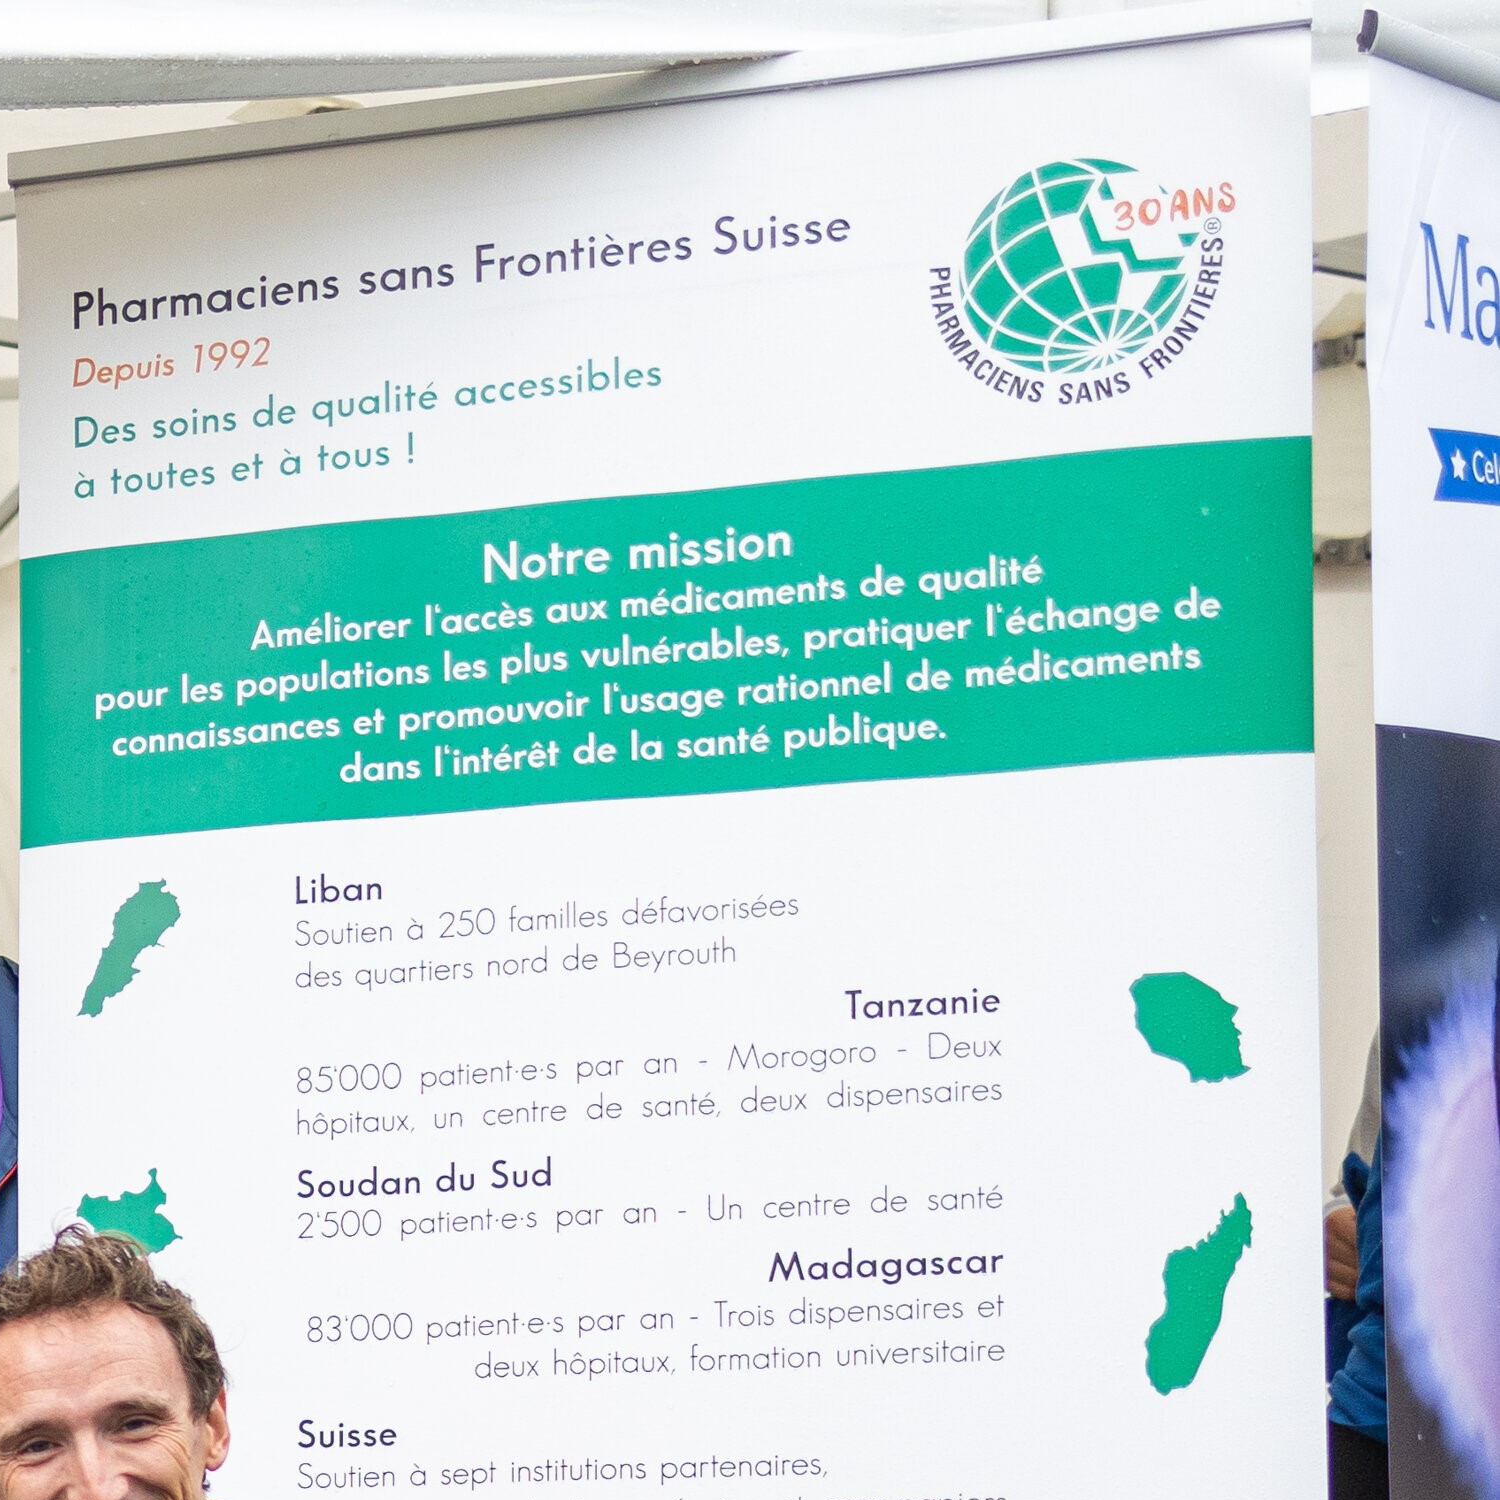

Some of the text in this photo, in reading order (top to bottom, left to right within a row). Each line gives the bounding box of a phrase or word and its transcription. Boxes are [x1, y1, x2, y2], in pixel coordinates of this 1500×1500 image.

[1112, 182, 1236, 231] 30 ANS
[74, 216, 851, 329] Pharmaciens sans Frontières Suisse
[929, 266, 1045, 404] PHARMACIENS
[1058, 371, 1131, 405] SANS
[72, 336, 271, 391] Depuis 1992
[74, 355, 662, 448] Des soins de qualité accessibles
[74, 445, 390, 499] à toutes et à tous
[484, 527, 792, 583] Notre mission
[251, 612, 411, 650] Améliorer
[546, 600, 608, 623] aux
[621, 574, 847, 617] médicaments
[860, 564, 905, 597] de
[919, 554, 1043, 600] qualité
[96, 687, 168, 720] pour
[182, 673, 224, 703] les
[237, 659, 430, 706] populations
[444, 650, 488, 681] les
[501, 642, 568, 684] plus
[581, 625, 789, 668] vulnérables,
[804, 618, 971, 658] pratiquer
[1174, 586, 1221, 619] de
[112, 718, 340, 756] connaissances
[353, 709, 385, 735] et
[399, 691, 589, 740] promouvoir
[738, 661, 891, 705] rationnel
[906, 658, 951, 692] de
[966, 643, 1201, 687] médicaments
[340, 751, 421, 783] dans
[573, 732, 617, 764] de
[631, 729, 663, 760] la
[678, 725, 770, 758] santé
[784, 712, 946, 757] publique.
[296, 873, 382, 905] Liban
[295, 894, 799, 946] Soutien à 250 familles défavorisées
[295, 936, 736, 992] des quartiers nord de Beyrouth
[844, 988, 1000, 1020] Tanzanie
[577, 1059, 624, 1084] par
[644, 1058, 678, 1074] an
[728, 1043, 876, 1073] Morogoro
[928, 1032, 1002, 1060] Deux
[297, 1080, 1002, 1141] hôpitaux, un centre de santé, deux dispensaires
[297, 1155, 551, 1199] Soudan du Sud
[557, 1209, 604, 1234] par
[623, 1207, 656, 1224] an
[708, 1193, 742, 1221] Un
[763, 1193, 850, 1219] centre
[870, 1184, 908, 1213] de
[928, 1184, 1003, 1211] santé
[768, 1247, 1004, 1285] Madagascar
[578, 1313, 626, 1339] par
[640, 1313, 674, 1330] an
[713, 1300, 774, 1328] Trois
[789, 1296, 964, 1330] dispensaires
[977, 1294, 1004, 1318] et
[474, 1340, 1005, 1382] deux hôpitaux, formation universitaire
[297, 1419, 397, 1449] Suisse
[297, 1455, 827, 1491] Soutien à sept institutions partenaires,
